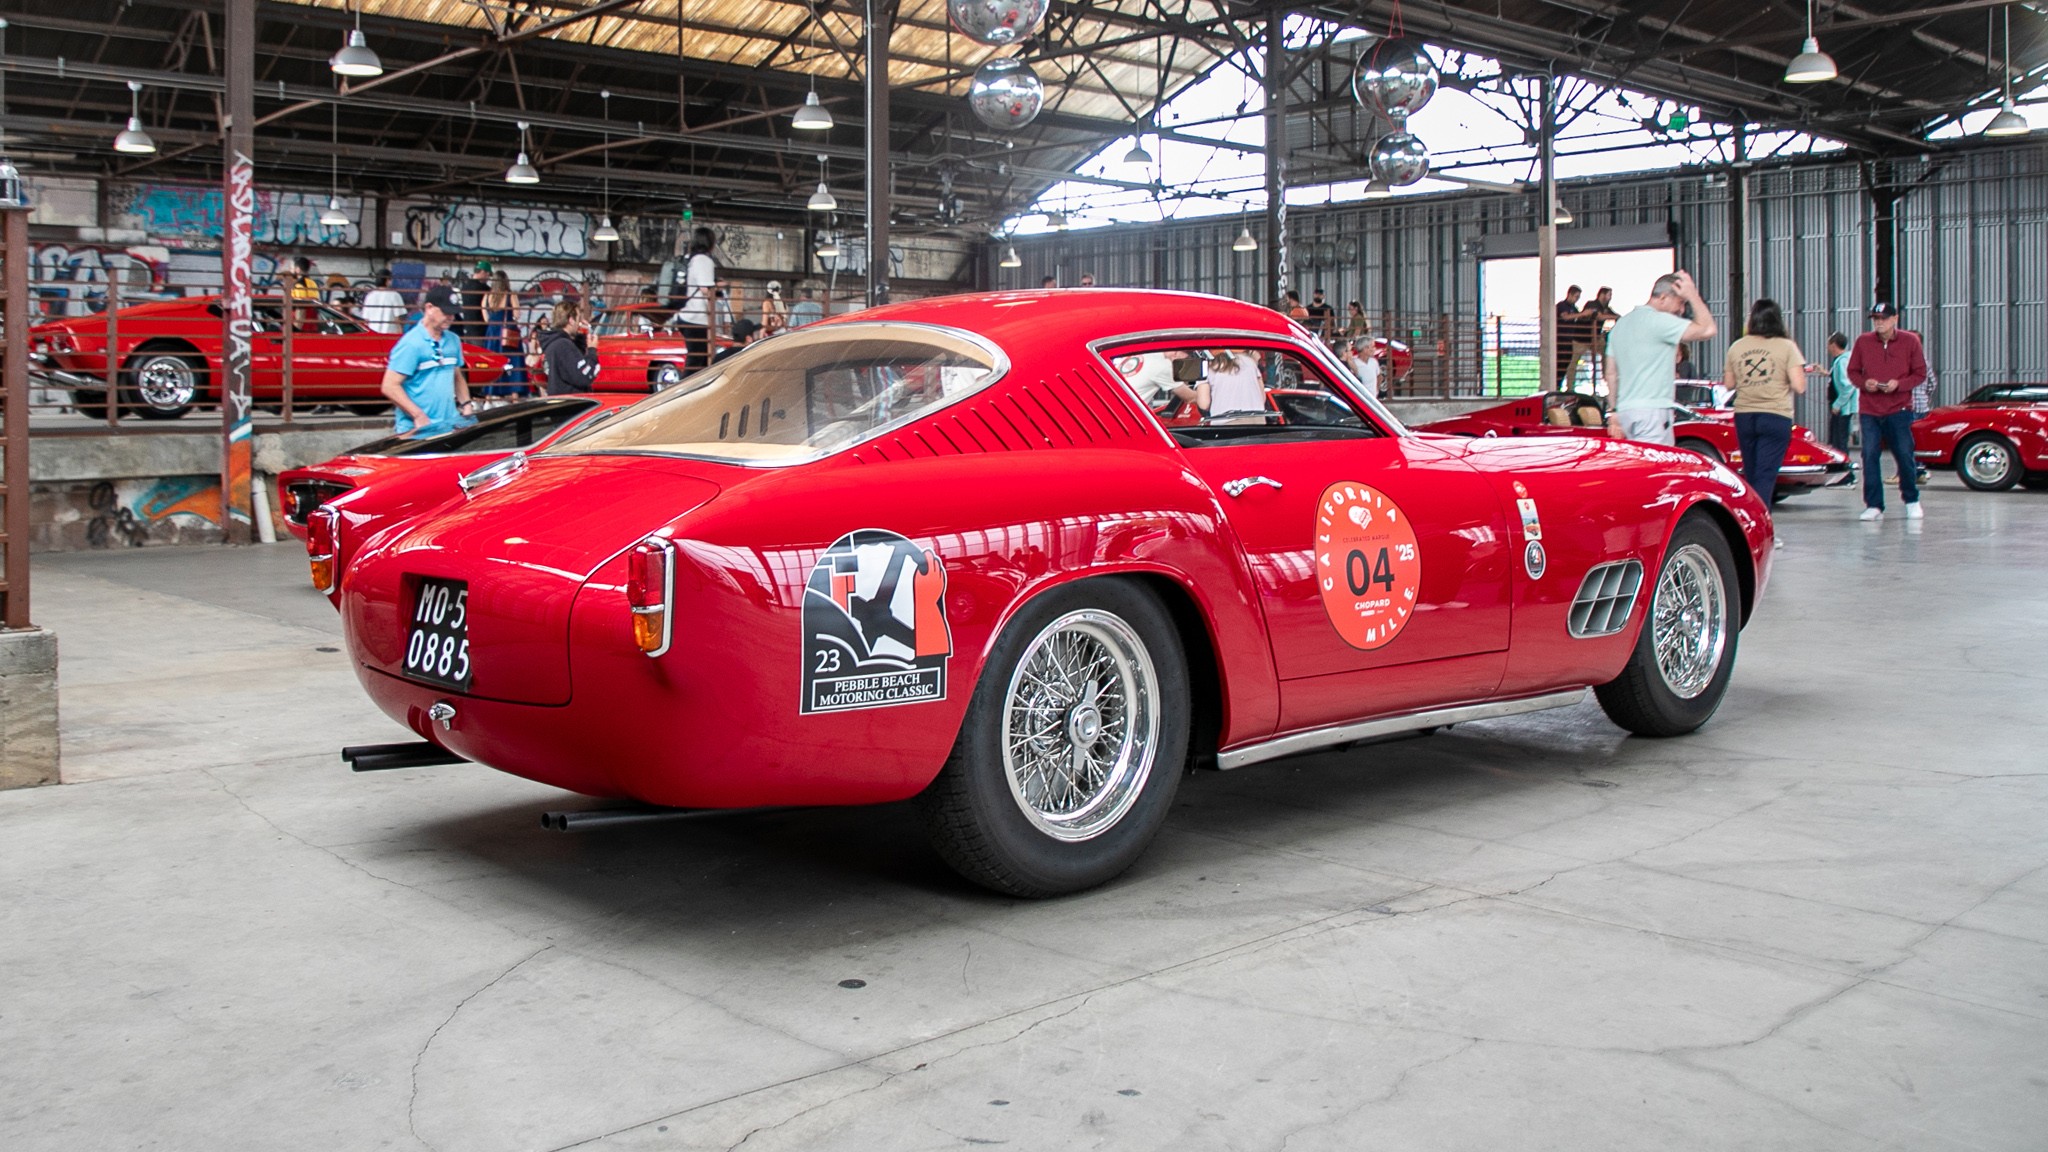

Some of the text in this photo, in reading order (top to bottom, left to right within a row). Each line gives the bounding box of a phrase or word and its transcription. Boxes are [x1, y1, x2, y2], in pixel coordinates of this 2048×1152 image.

[1320, 487, 1397, 591] CALIFORNIA
[1395, 544, 1415, 561] '25
[1346, 547, 1395, 596] 04
[1354, 598, 1391, 611] CHOPARD
[1366, 587, 1414, 642] MILLE
[408, 630, 469, 680] 0885
[815, 649, 840, 673] 23
[835, 673, 921, 692] PEBBLE BEACH
[819, 684, 934, 706] MOTORING CLASSIC
